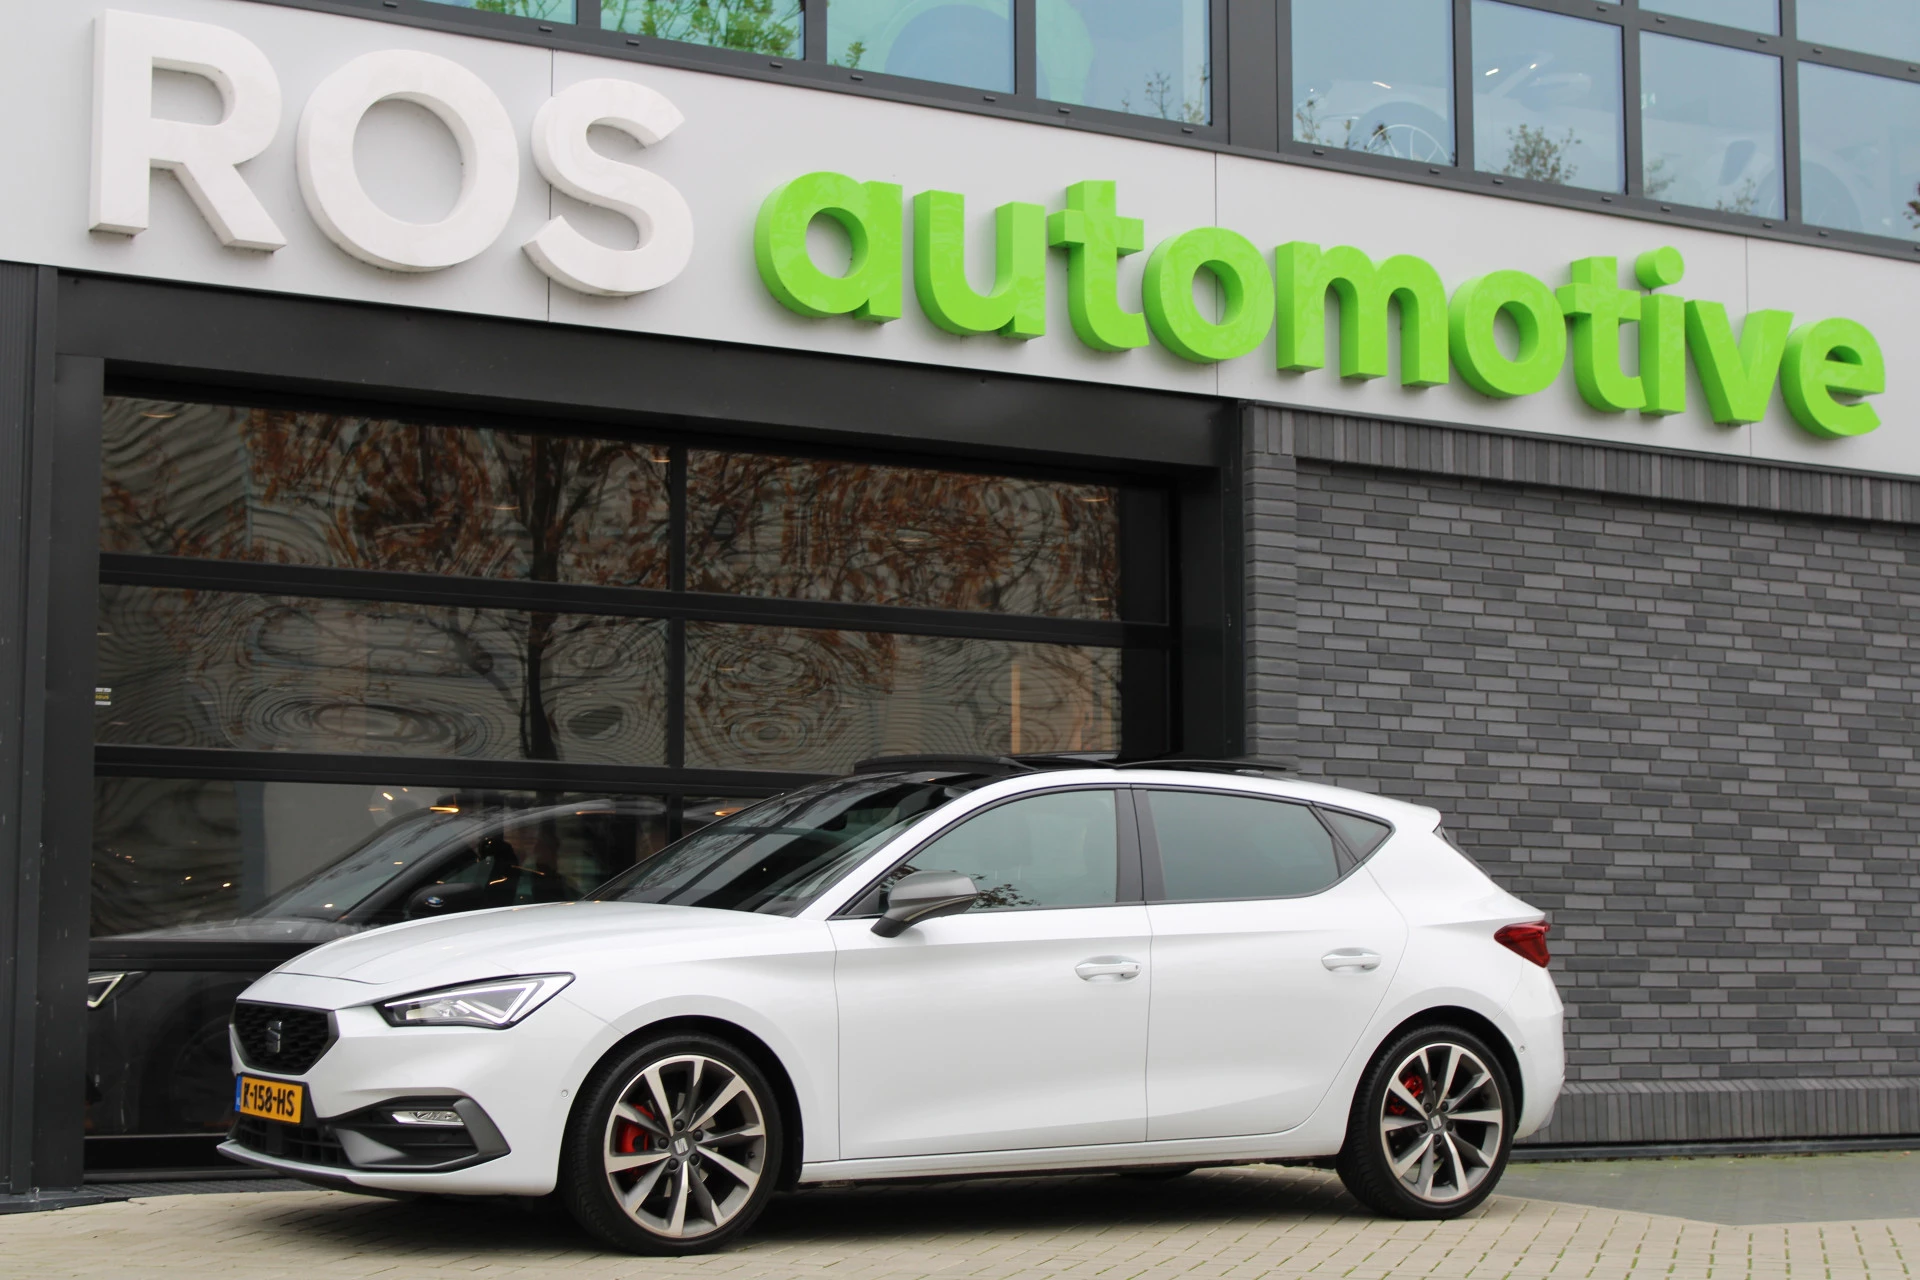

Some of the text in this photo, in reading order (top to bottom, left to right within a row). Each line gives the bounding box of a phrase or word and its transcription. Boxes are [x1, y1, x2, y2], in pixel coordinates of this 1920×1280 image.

[89, 9, 1886, 438] ROS automotive
[243, 1082, 295, 1116] K-158-HS
